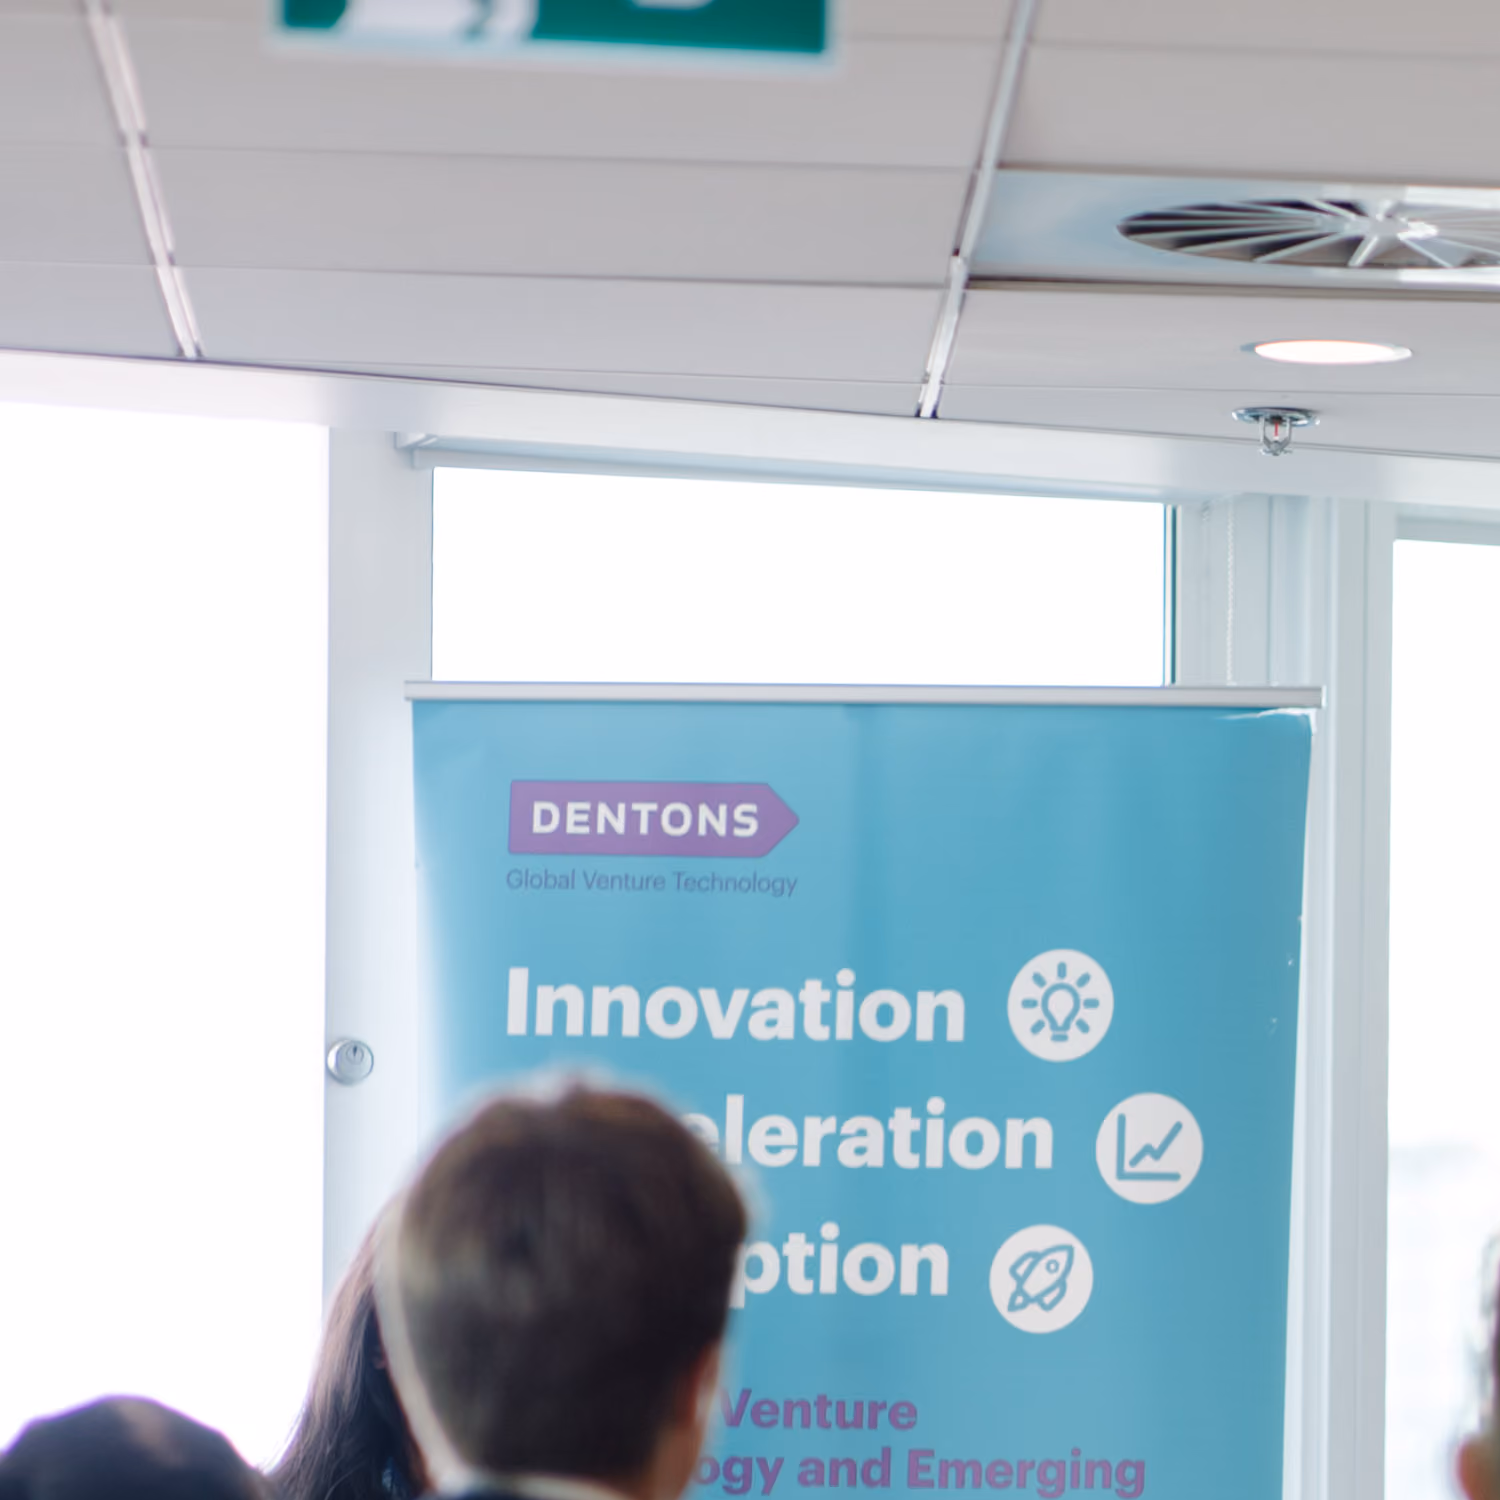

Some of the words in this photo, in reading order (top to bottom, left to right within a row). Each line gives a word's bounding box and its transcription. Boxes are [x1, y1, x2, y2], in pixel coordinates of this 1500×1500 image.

[532, 800, 759, 837] DENTONS
[506, 868, 576, 891] Global
[582, 870, 666, 892] Venture
[672, 871, 799, 898] Technology
[506, 966, 966, 1043] Innovation
[719, 1388, 918, 1431] Venture
[797, 1446, 892, 1489] and
[907, 1446, 1147, 1500] Emerging
